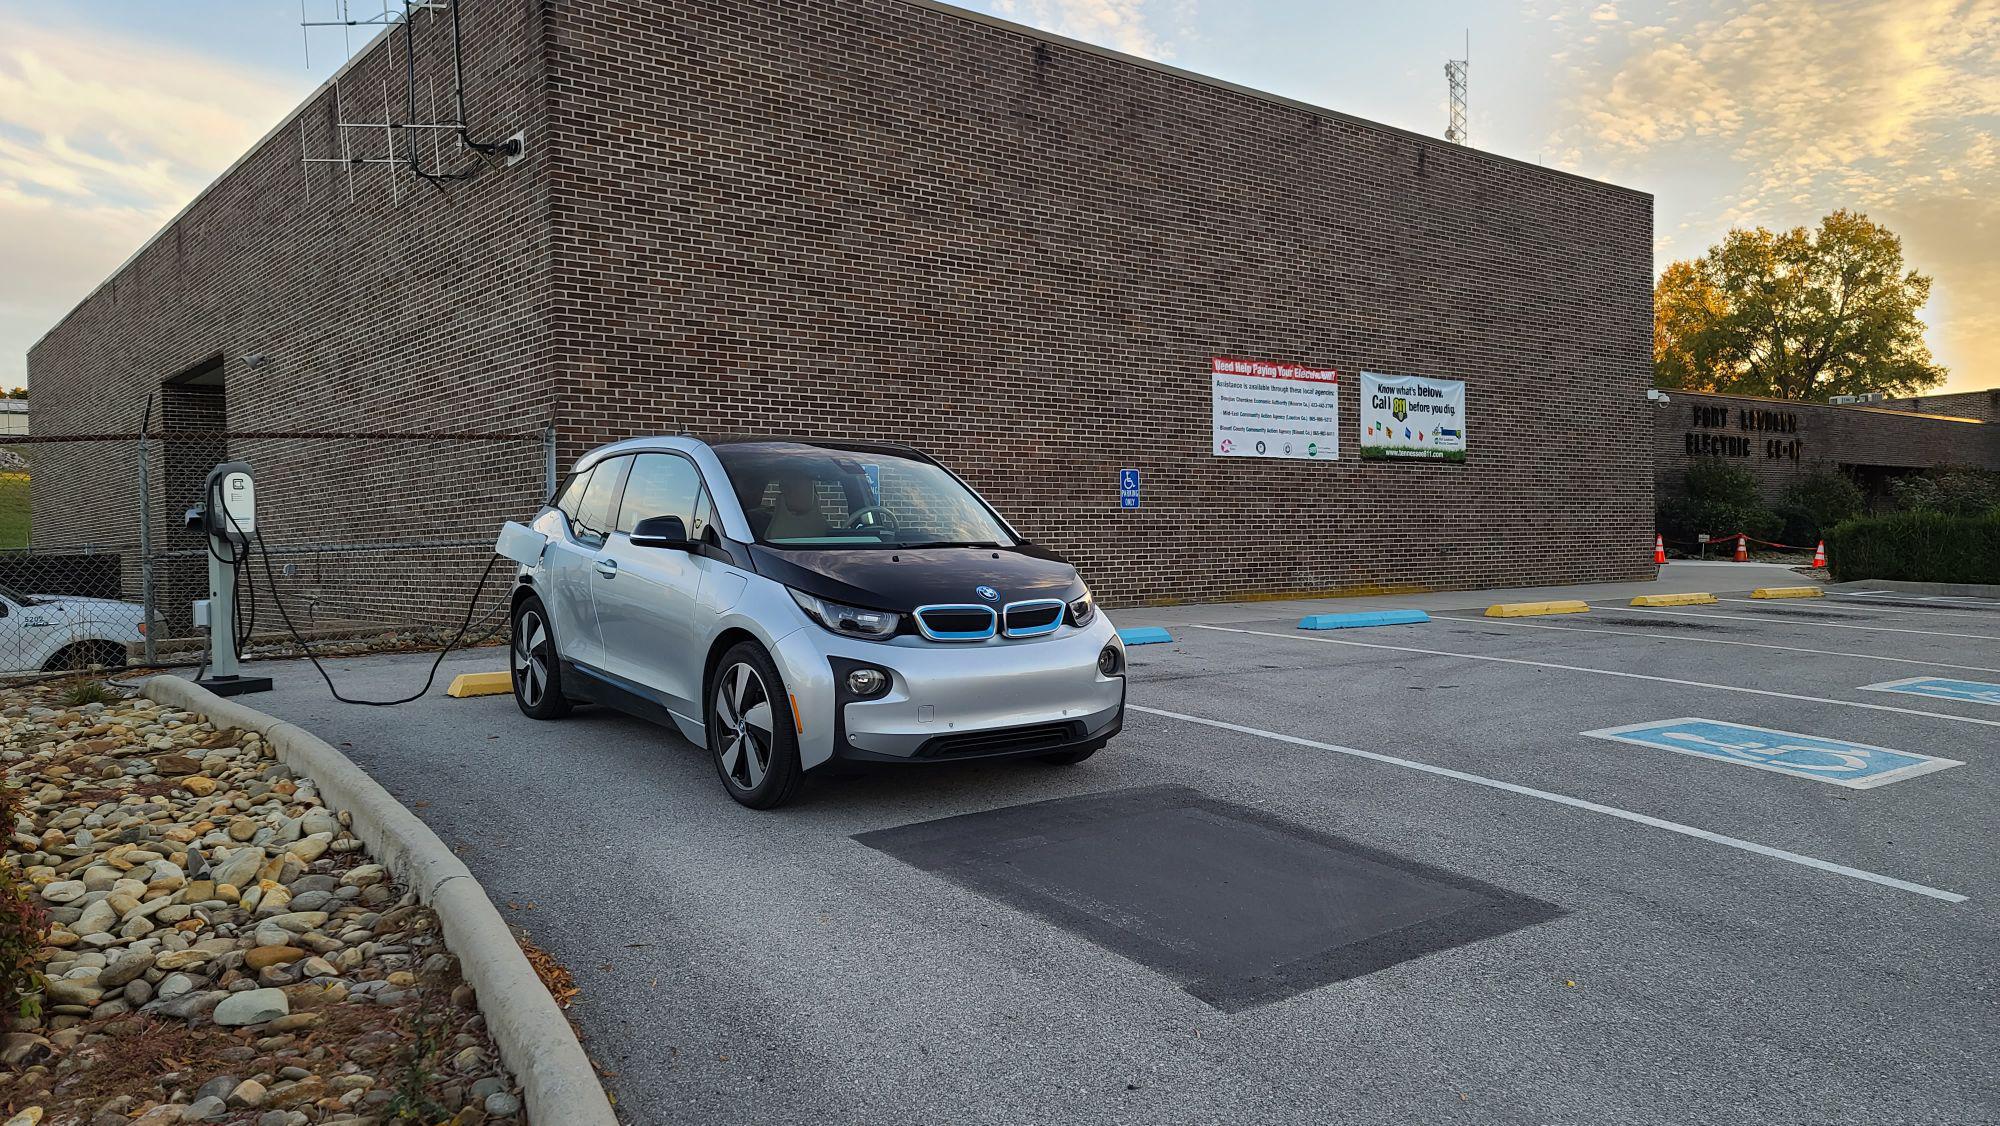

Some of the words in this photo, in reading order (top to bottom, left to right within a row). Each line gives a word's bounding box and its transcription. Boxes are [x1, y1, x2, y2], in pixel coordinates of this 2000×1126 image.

[1215, 359, 1234, 372] Need
[1235, 361, 1252, 375] Help
[1252, 363, 1277, 378] Paying
[1277, 366, 1293, 377] Your
[1302, 387, 1314, 395] local
[1377, 383, 1395, 395] Know
[1396, 385, 1417, 396] what's
[1417, 384, 1443, 398] below.
[1372, 394, 1391, 410] Call
[1393, 397, 1407, 413] 811
[1408, 401, 1430, 413] before
[1431, 405, 1443, 416] you
[1444, 404, 1456, 416] dig.
[1693, 405, 1728, 428] FORT
[1685, 432, 1751, 457] ELECTRIC
